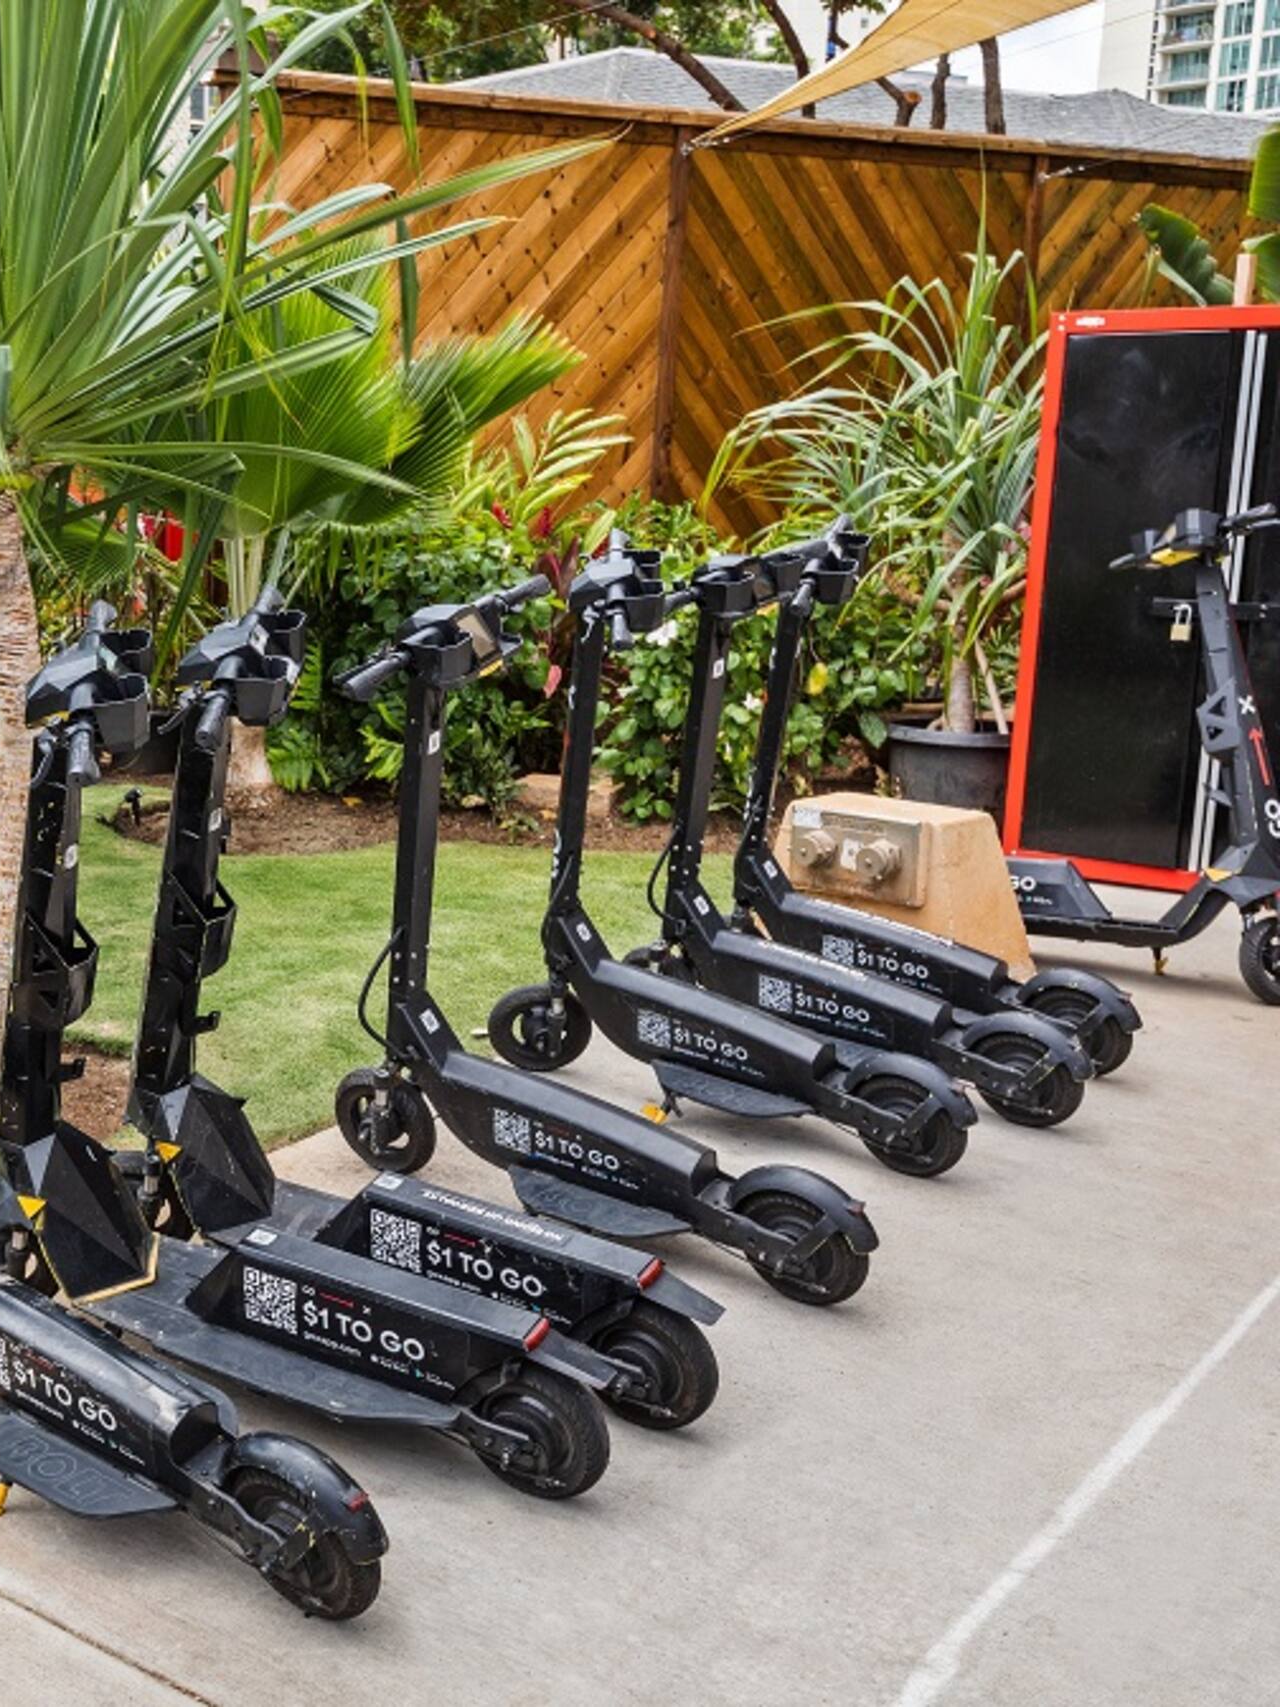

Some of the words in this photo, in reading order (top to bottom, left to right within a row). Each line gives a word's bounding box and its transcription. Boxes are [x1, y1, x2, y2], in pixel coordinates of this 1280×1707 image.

[1238, 695, 1256, 715] X
[876, 957, 899, 972] TO
[902, 962, 929, 979] GO
[816, 998, 839, 1015] TO
[842, 1005, 870, 1023] GO
[693, 1032, 717, 1051] TO
[721, 1042, 748, 1061] GO
[534, 1130, 555, 1149] $1
[558, 1138, 584, 1159] TO
[588, 1149, 619, 1170] GO
[426, 1239, 454, 1267] $1
[458, 1252, 494, 1281] TO
[500, 1268, 544, 1297] GO
[303, 1300, 329, 1330] $1
[335, 1312, 373, 1343] TO
[380, 1331, 425, 1361] GO
[12, 1360, 37, 1389] $1
[40, 1373, 72, 1406] TO
[77, 1397, 117, 1431] GO
